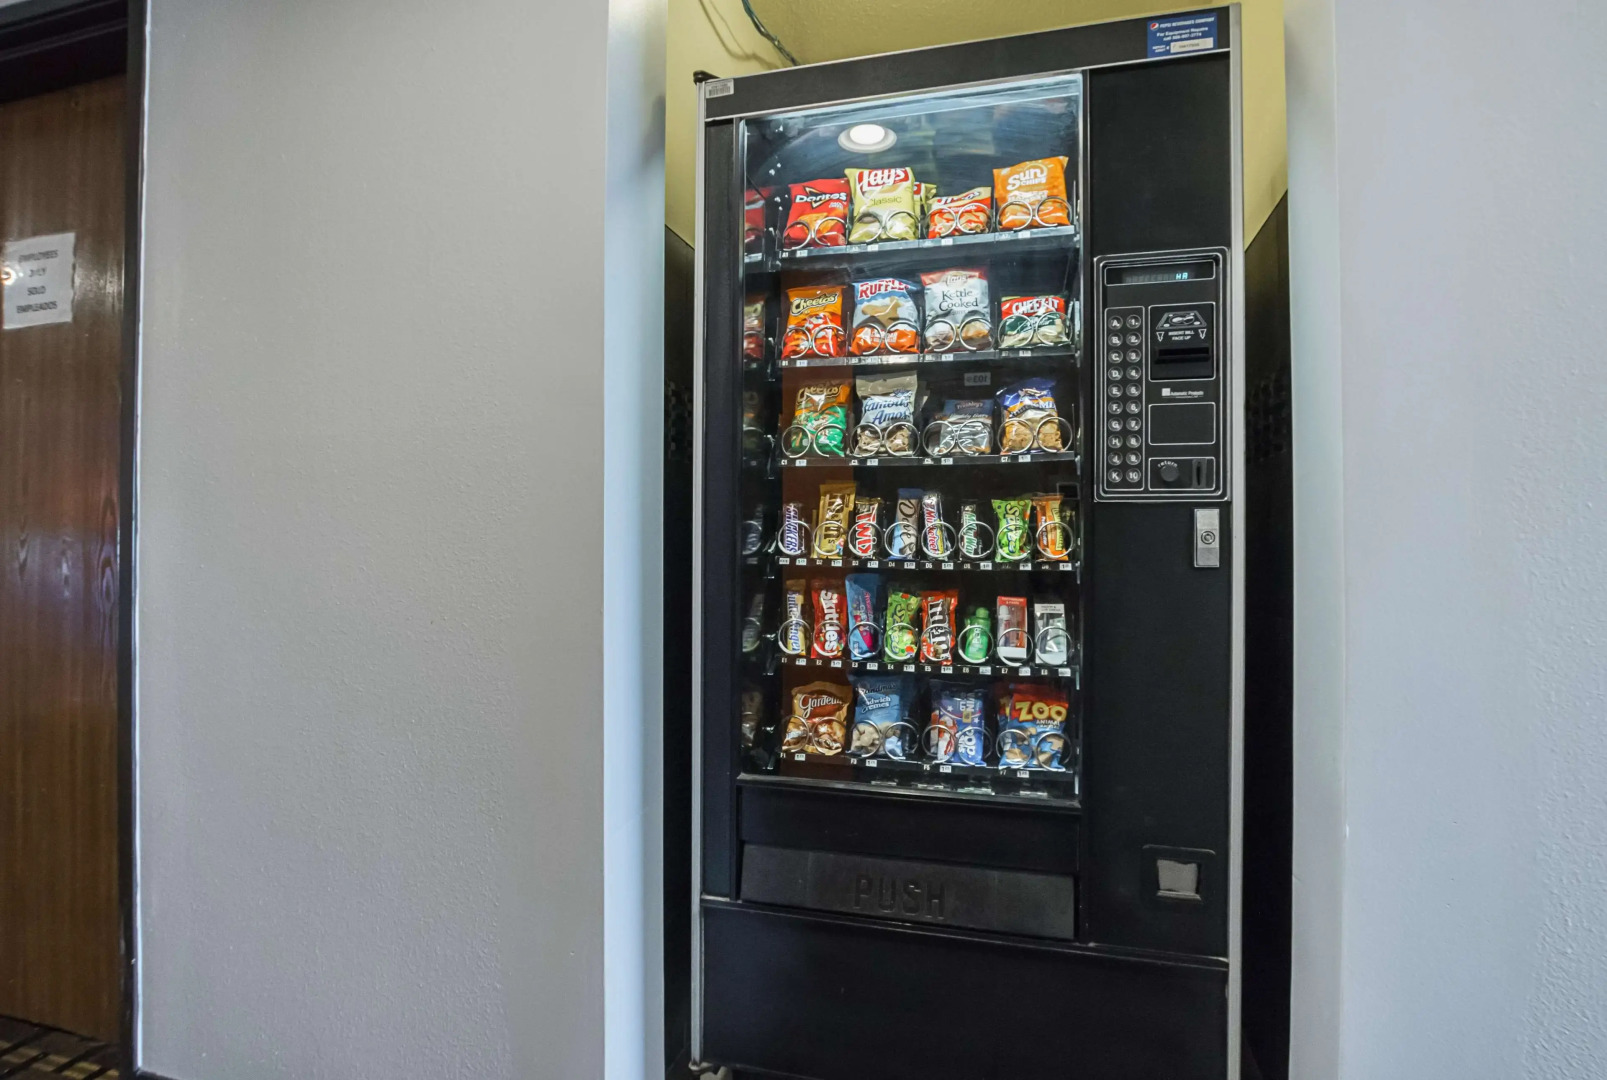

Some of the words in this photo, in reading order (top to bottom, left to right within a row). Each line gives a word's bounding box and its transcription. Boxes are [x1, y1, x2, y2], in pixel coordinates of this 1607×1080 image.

[1007, 168, 1047, 190] Sun
[795, 192, 847, 203] Doritos
[790, 293, 838, 316] Cheetos
[939, 298, 978, 312] Cooked
[872, 410, 907, 424] Amos
[1158, 460, 1178, 468] return
[786, 505, 799, 553] SNICKERS
[820, 590, 840, 651] Skittles
[1016, 701, 1067, 722] ZOO
[854, 873, 947, 919] PUSH
